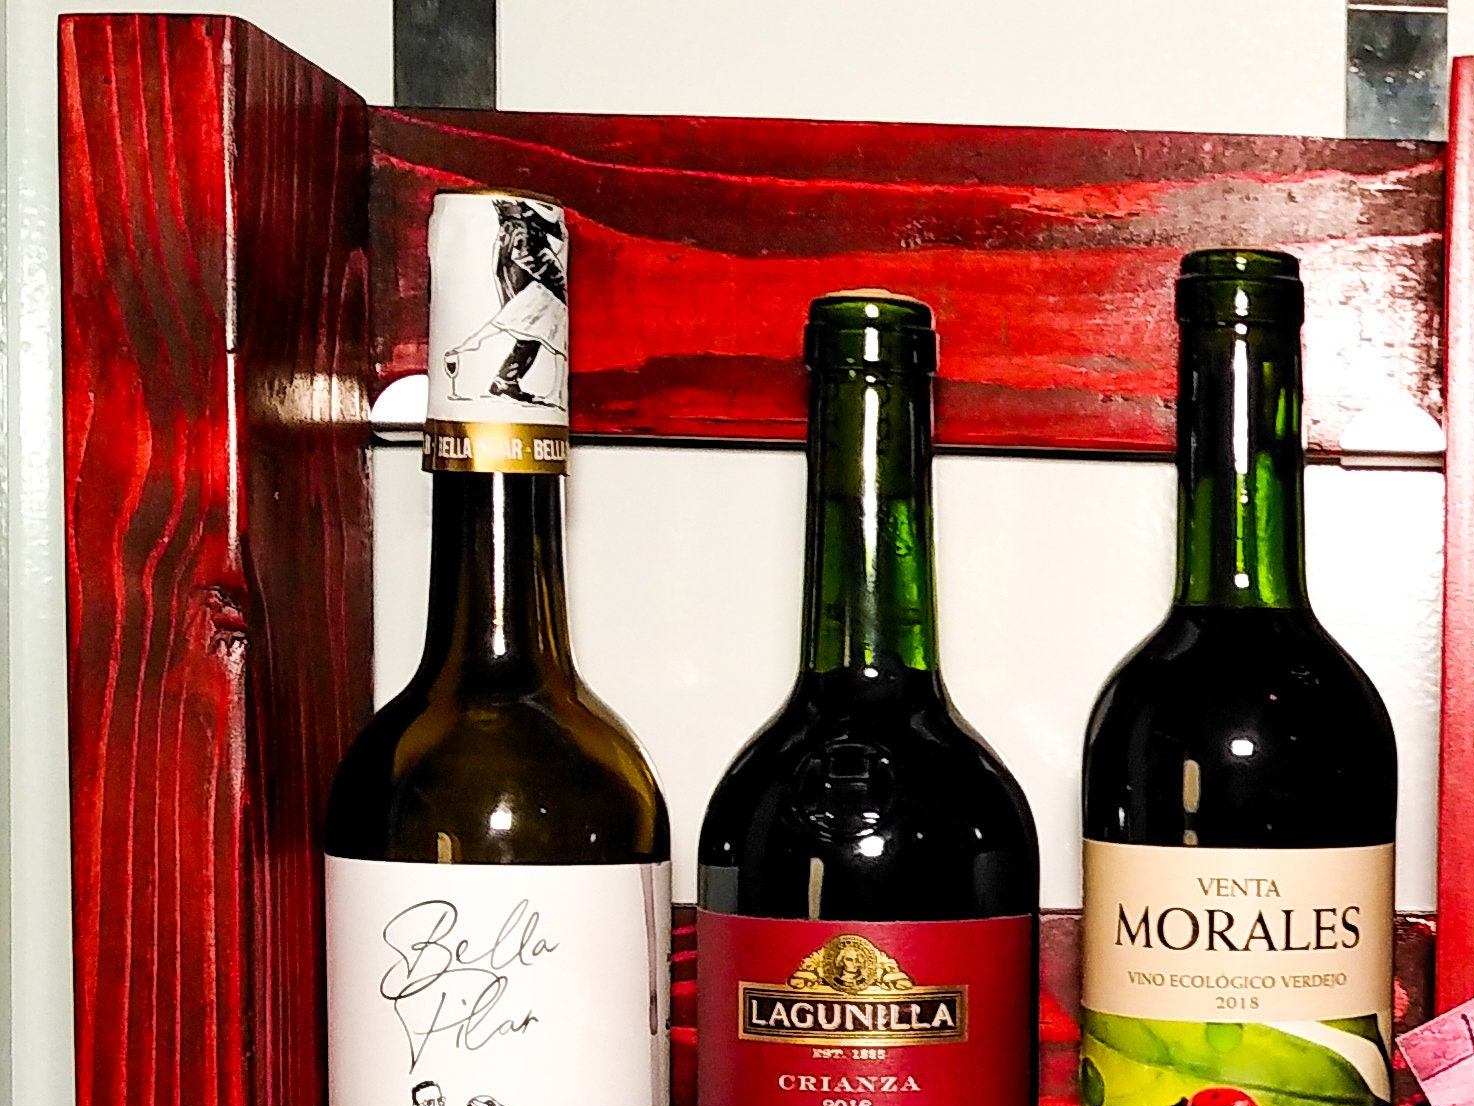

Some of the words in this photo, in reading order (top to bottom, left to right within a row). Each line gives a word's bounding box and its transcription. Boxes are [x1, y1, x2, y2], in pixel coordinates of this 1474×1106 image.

[1197, 877, 1281, 897] VENTA
[1114, 903, 1360, 952] MORALES
[380, 899, 559, 1000] Bella
[1128, 971, 1165, 987] VINO
[1170, 971, 1276, 989] ECOLÓGICO
[1281, 972, 1348, 988] VERDEJO
[751, 998, 955, 1032] LAGUNILLA
[1216, 997, 1260, 1009] 2018
[392, 968, 540, 1075] Pilar
[778, 1075, 921, 1093] CRIANZA
